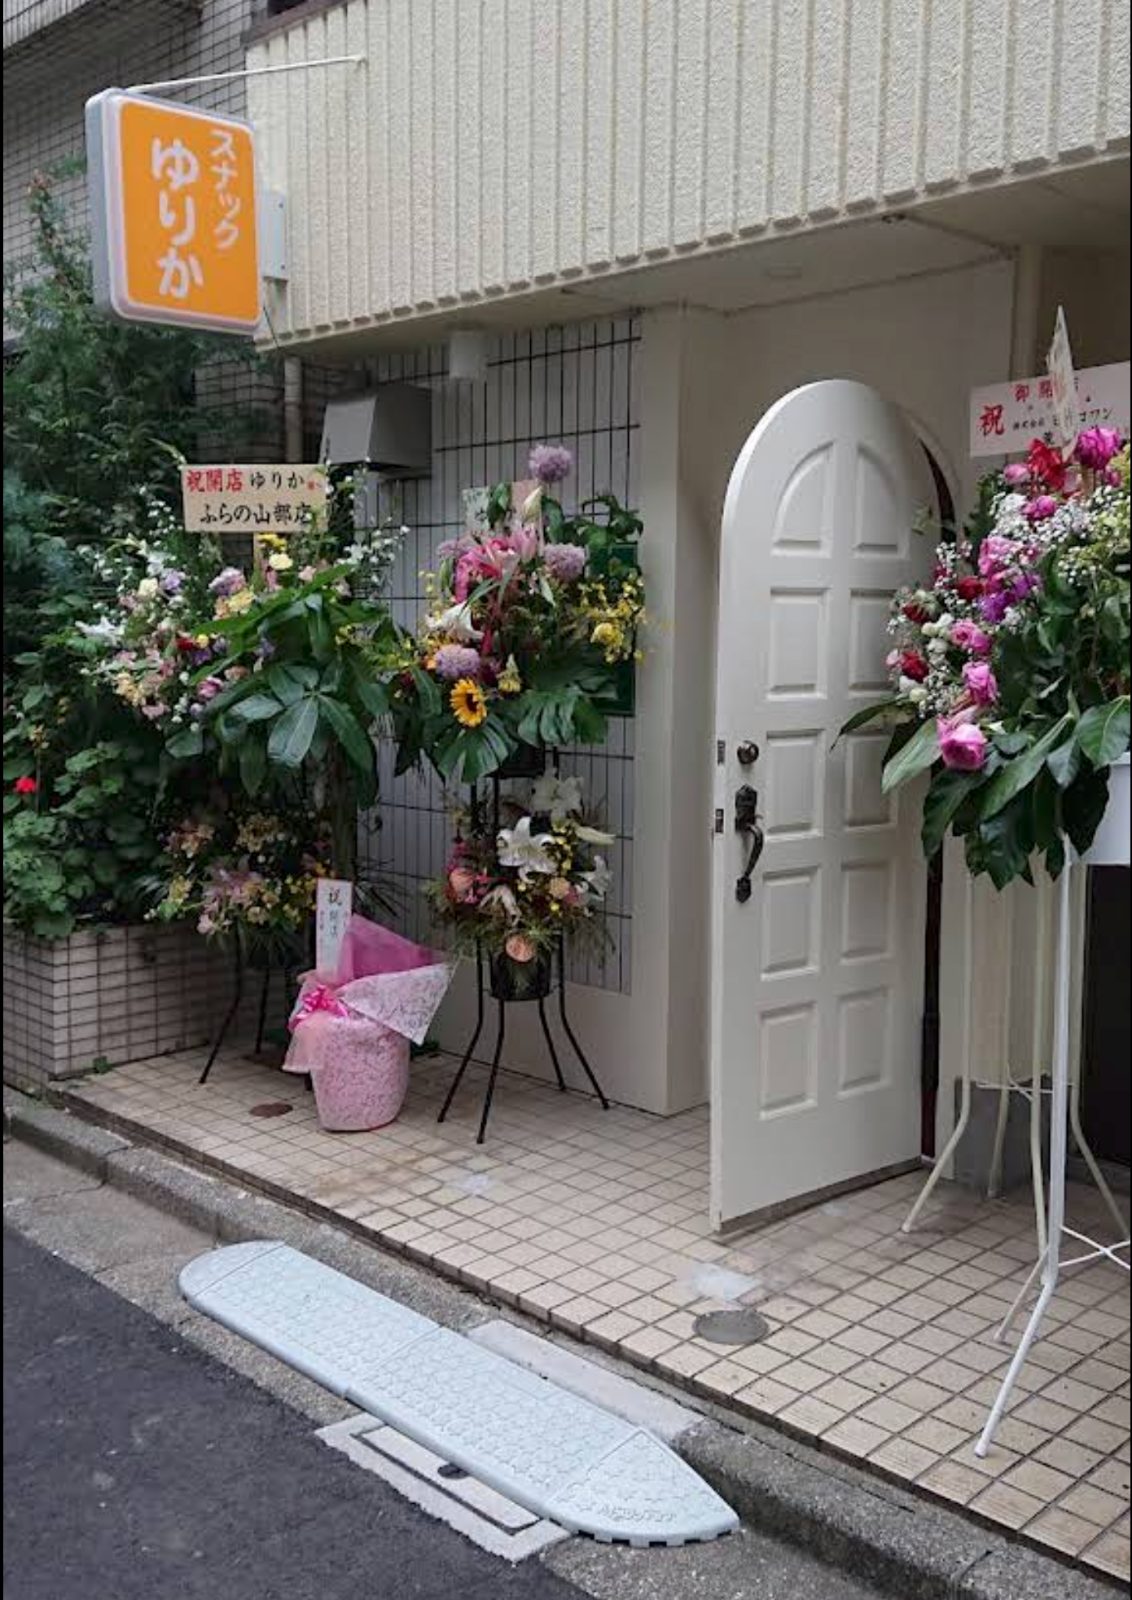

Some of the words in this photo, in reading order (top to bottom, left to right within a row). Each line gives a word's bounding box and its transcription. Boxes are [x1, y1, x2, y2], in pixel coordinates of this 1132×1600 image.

[210, 129, 242, 250] スナック
[152, 137, 204, 299] ゆりか
[979, 404, 1005, 437] 祝
[187, 468, 243, 493] 祝開店
[251, 471, 304, 489] ゆりか
[200, 502, 313, 525] ふらの山部店
